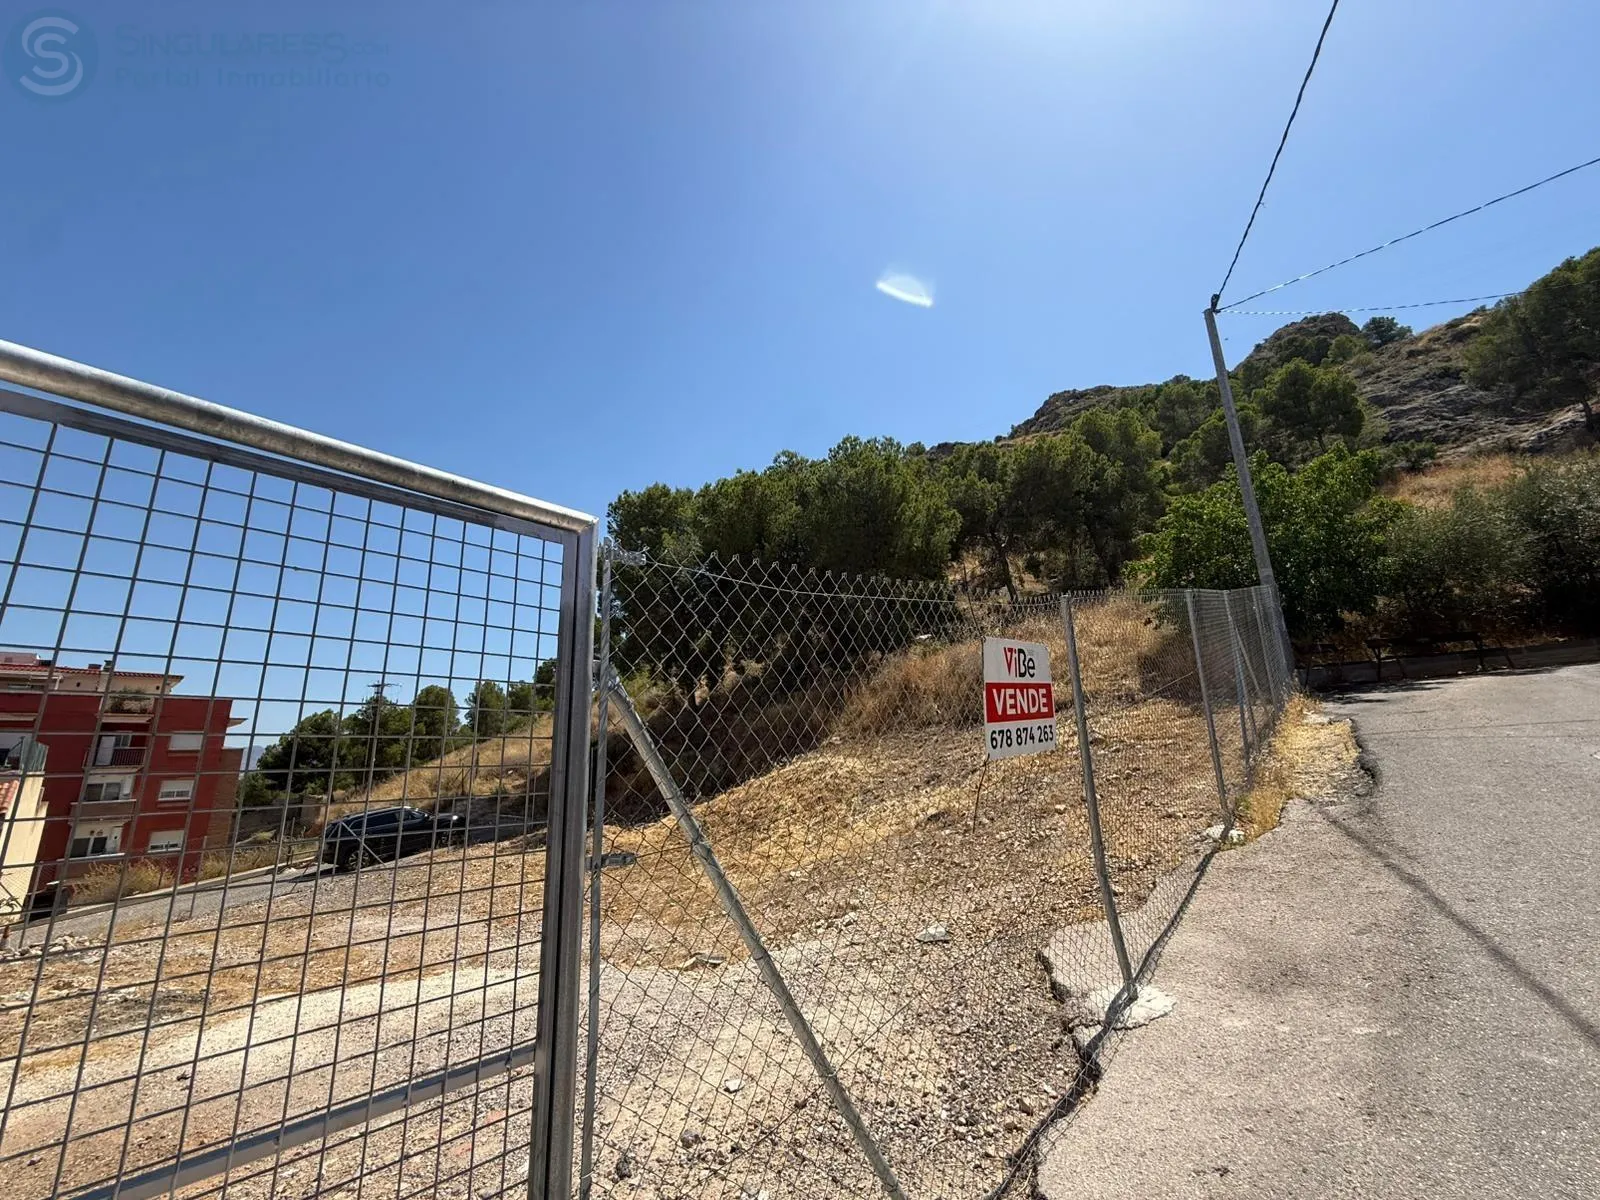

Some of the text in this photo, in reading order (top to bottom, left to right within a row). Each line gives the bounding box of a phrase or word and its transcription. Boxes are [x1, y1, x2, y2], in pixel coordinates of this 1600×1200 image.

[992, 688, 1049, 716] VENDE
[990, 724, 1054, 749] 678 874 263
